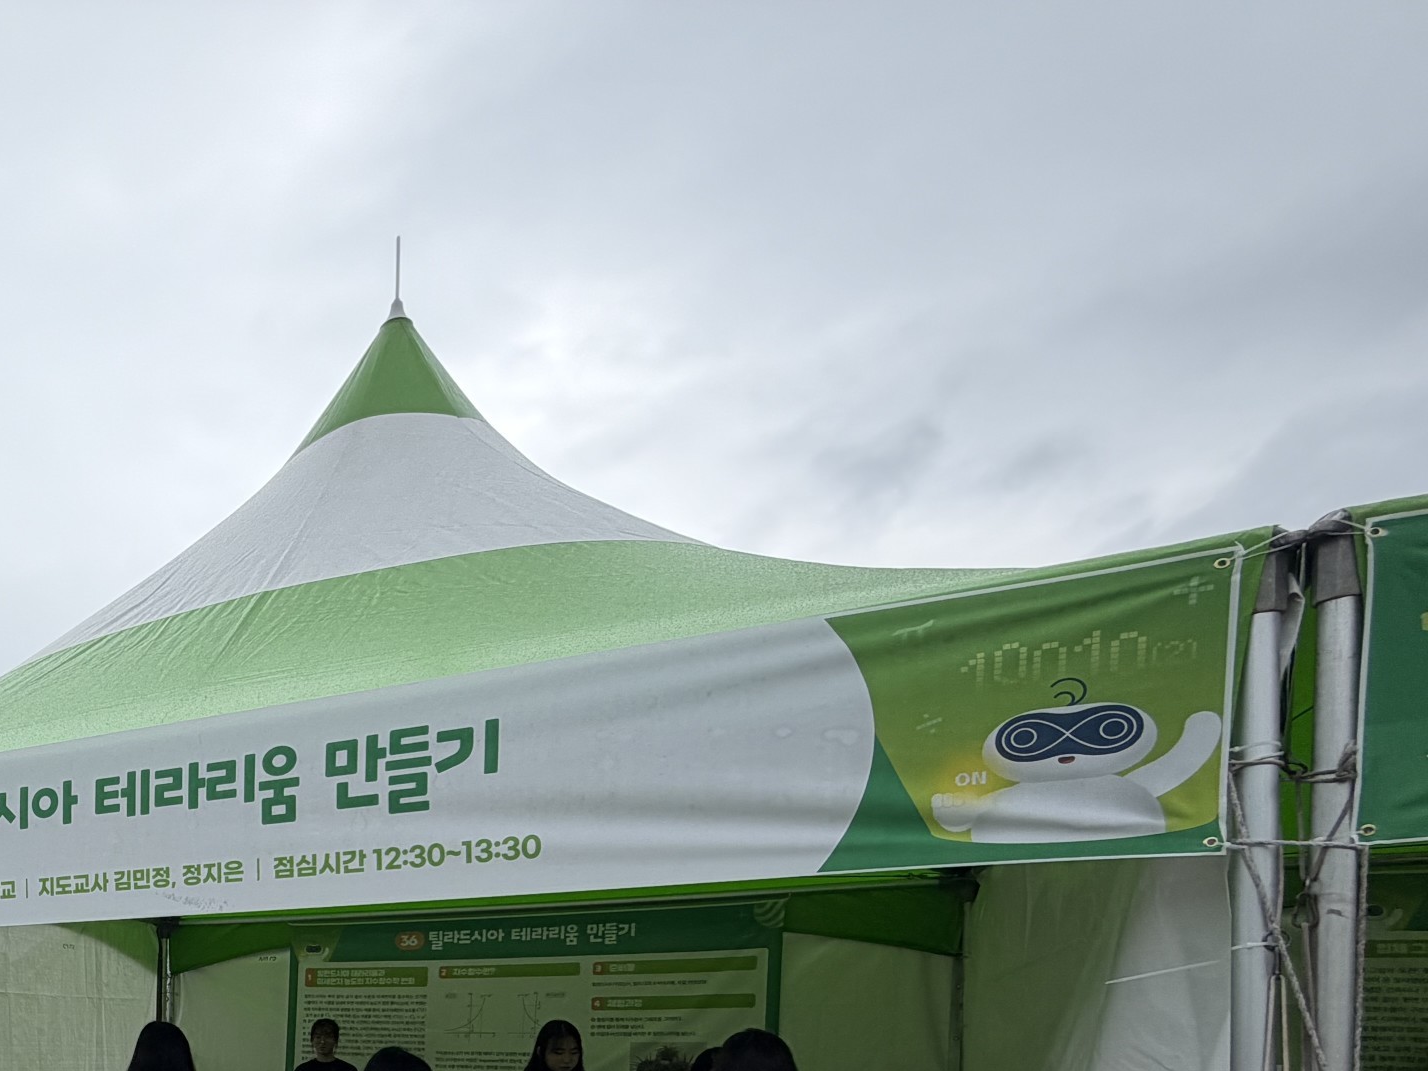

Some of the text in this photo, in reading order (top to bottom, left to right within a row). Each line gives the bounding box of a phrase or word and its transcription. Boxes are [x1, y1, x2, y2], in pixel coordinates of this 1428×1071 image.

[94, 745, 301, 825] 테라리움
[324, 718, 500, 815] 만들기
[955, 770, 987, 787] ON
[38, 872, 110, 897] 지도교사
[113, 866, 176, 892] 김민정,
[181, 860, 245, 887] 정지은
[272, 849, 367, 880] 점심시간
[371, 834, 543, 872] 12:30~13:30
[400, 922, 637, 951] 36 틸라드시아 테라리움 만들기
